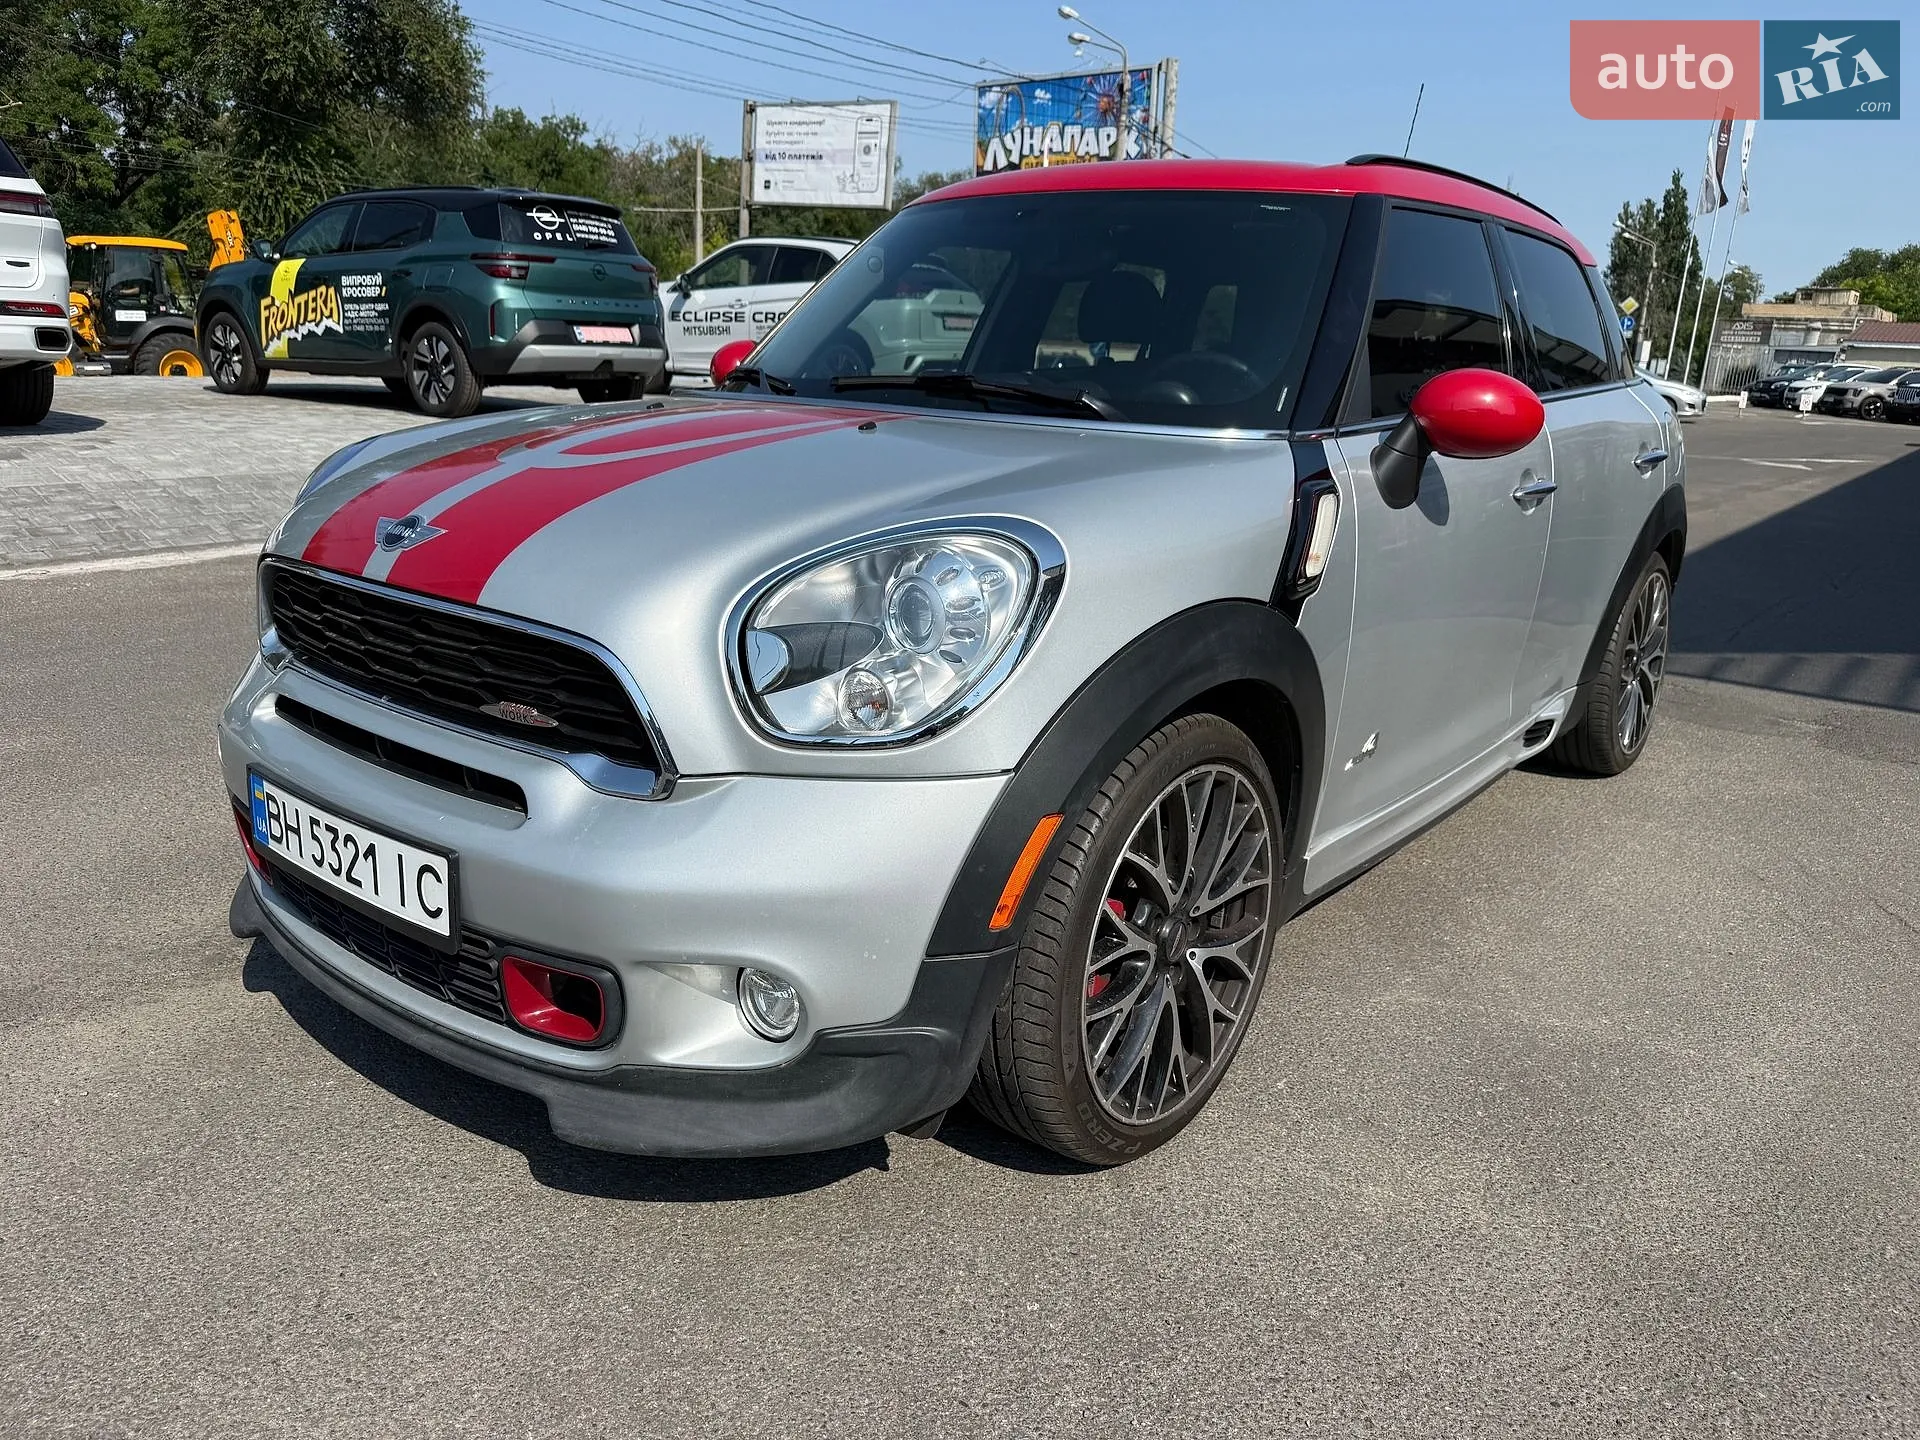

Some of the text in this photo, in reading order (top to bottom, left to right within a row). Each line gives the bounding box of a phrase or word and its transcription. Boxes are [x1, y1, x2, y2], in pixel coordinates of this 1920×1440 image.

[983, 123, 1141, 171] ЛУНАПАРК
[765, 152, 776, 161] від
[778, 152, 786, 160] 10
[533, 232, 573, 241] OPEL
[341, 272, 382, 286] ВИПРОБУЙ
[342, 286, 380, 298] КРОСОВЕР
[260, 285, 339, 350] FRONTERA
[671, 311, 745, 323] ECLIPSE
[683, 325, 731, 336] MITSUBISHI
[500, 709, 535, 725] WORKS
[256, 815, 268, 835] UA
[265, 791, 443, 919] BH 5321 IC
